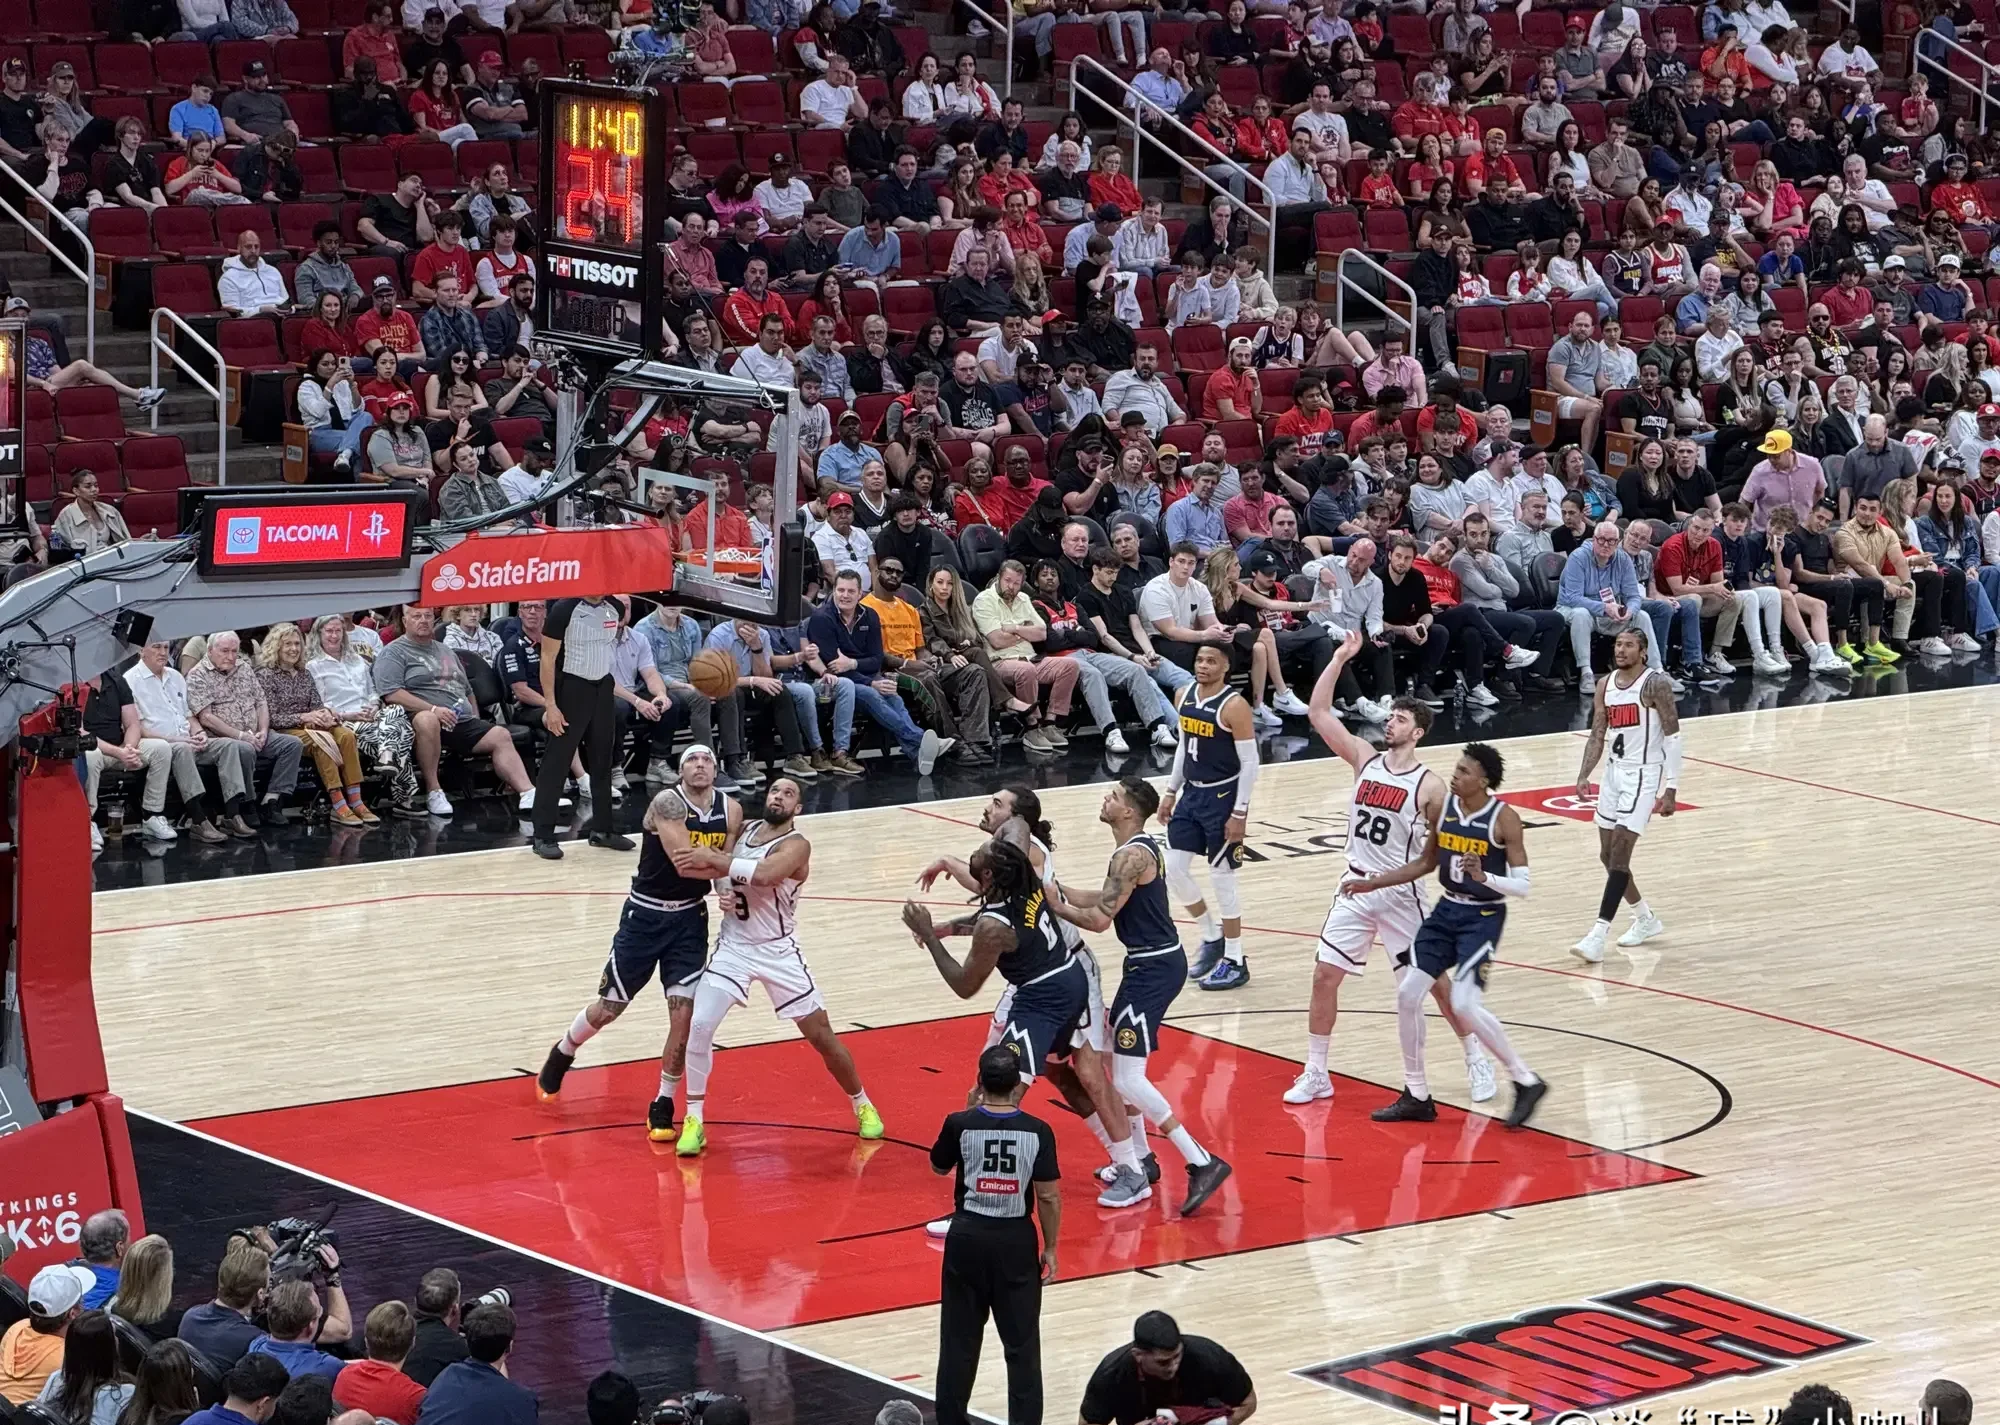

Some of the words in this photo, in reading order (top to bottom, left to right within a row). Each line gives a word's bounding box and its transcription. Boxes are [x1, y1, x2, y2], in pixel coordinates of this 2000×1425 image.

[571, 103, 640, 157] 11:40
[566, 153, 633, 243] 24
[571, 259, 638, 289] TISSOT
[266, 524, 339, 543] TACOMA
[1187, 736, 1199, 762] 4
[1612, 732, 1625, 760] 4
[1354, 809, 1392, 847] 28
[982, 1139, 1017, 1174] 55
[979, 1180, 1016, 1192] Emirates
